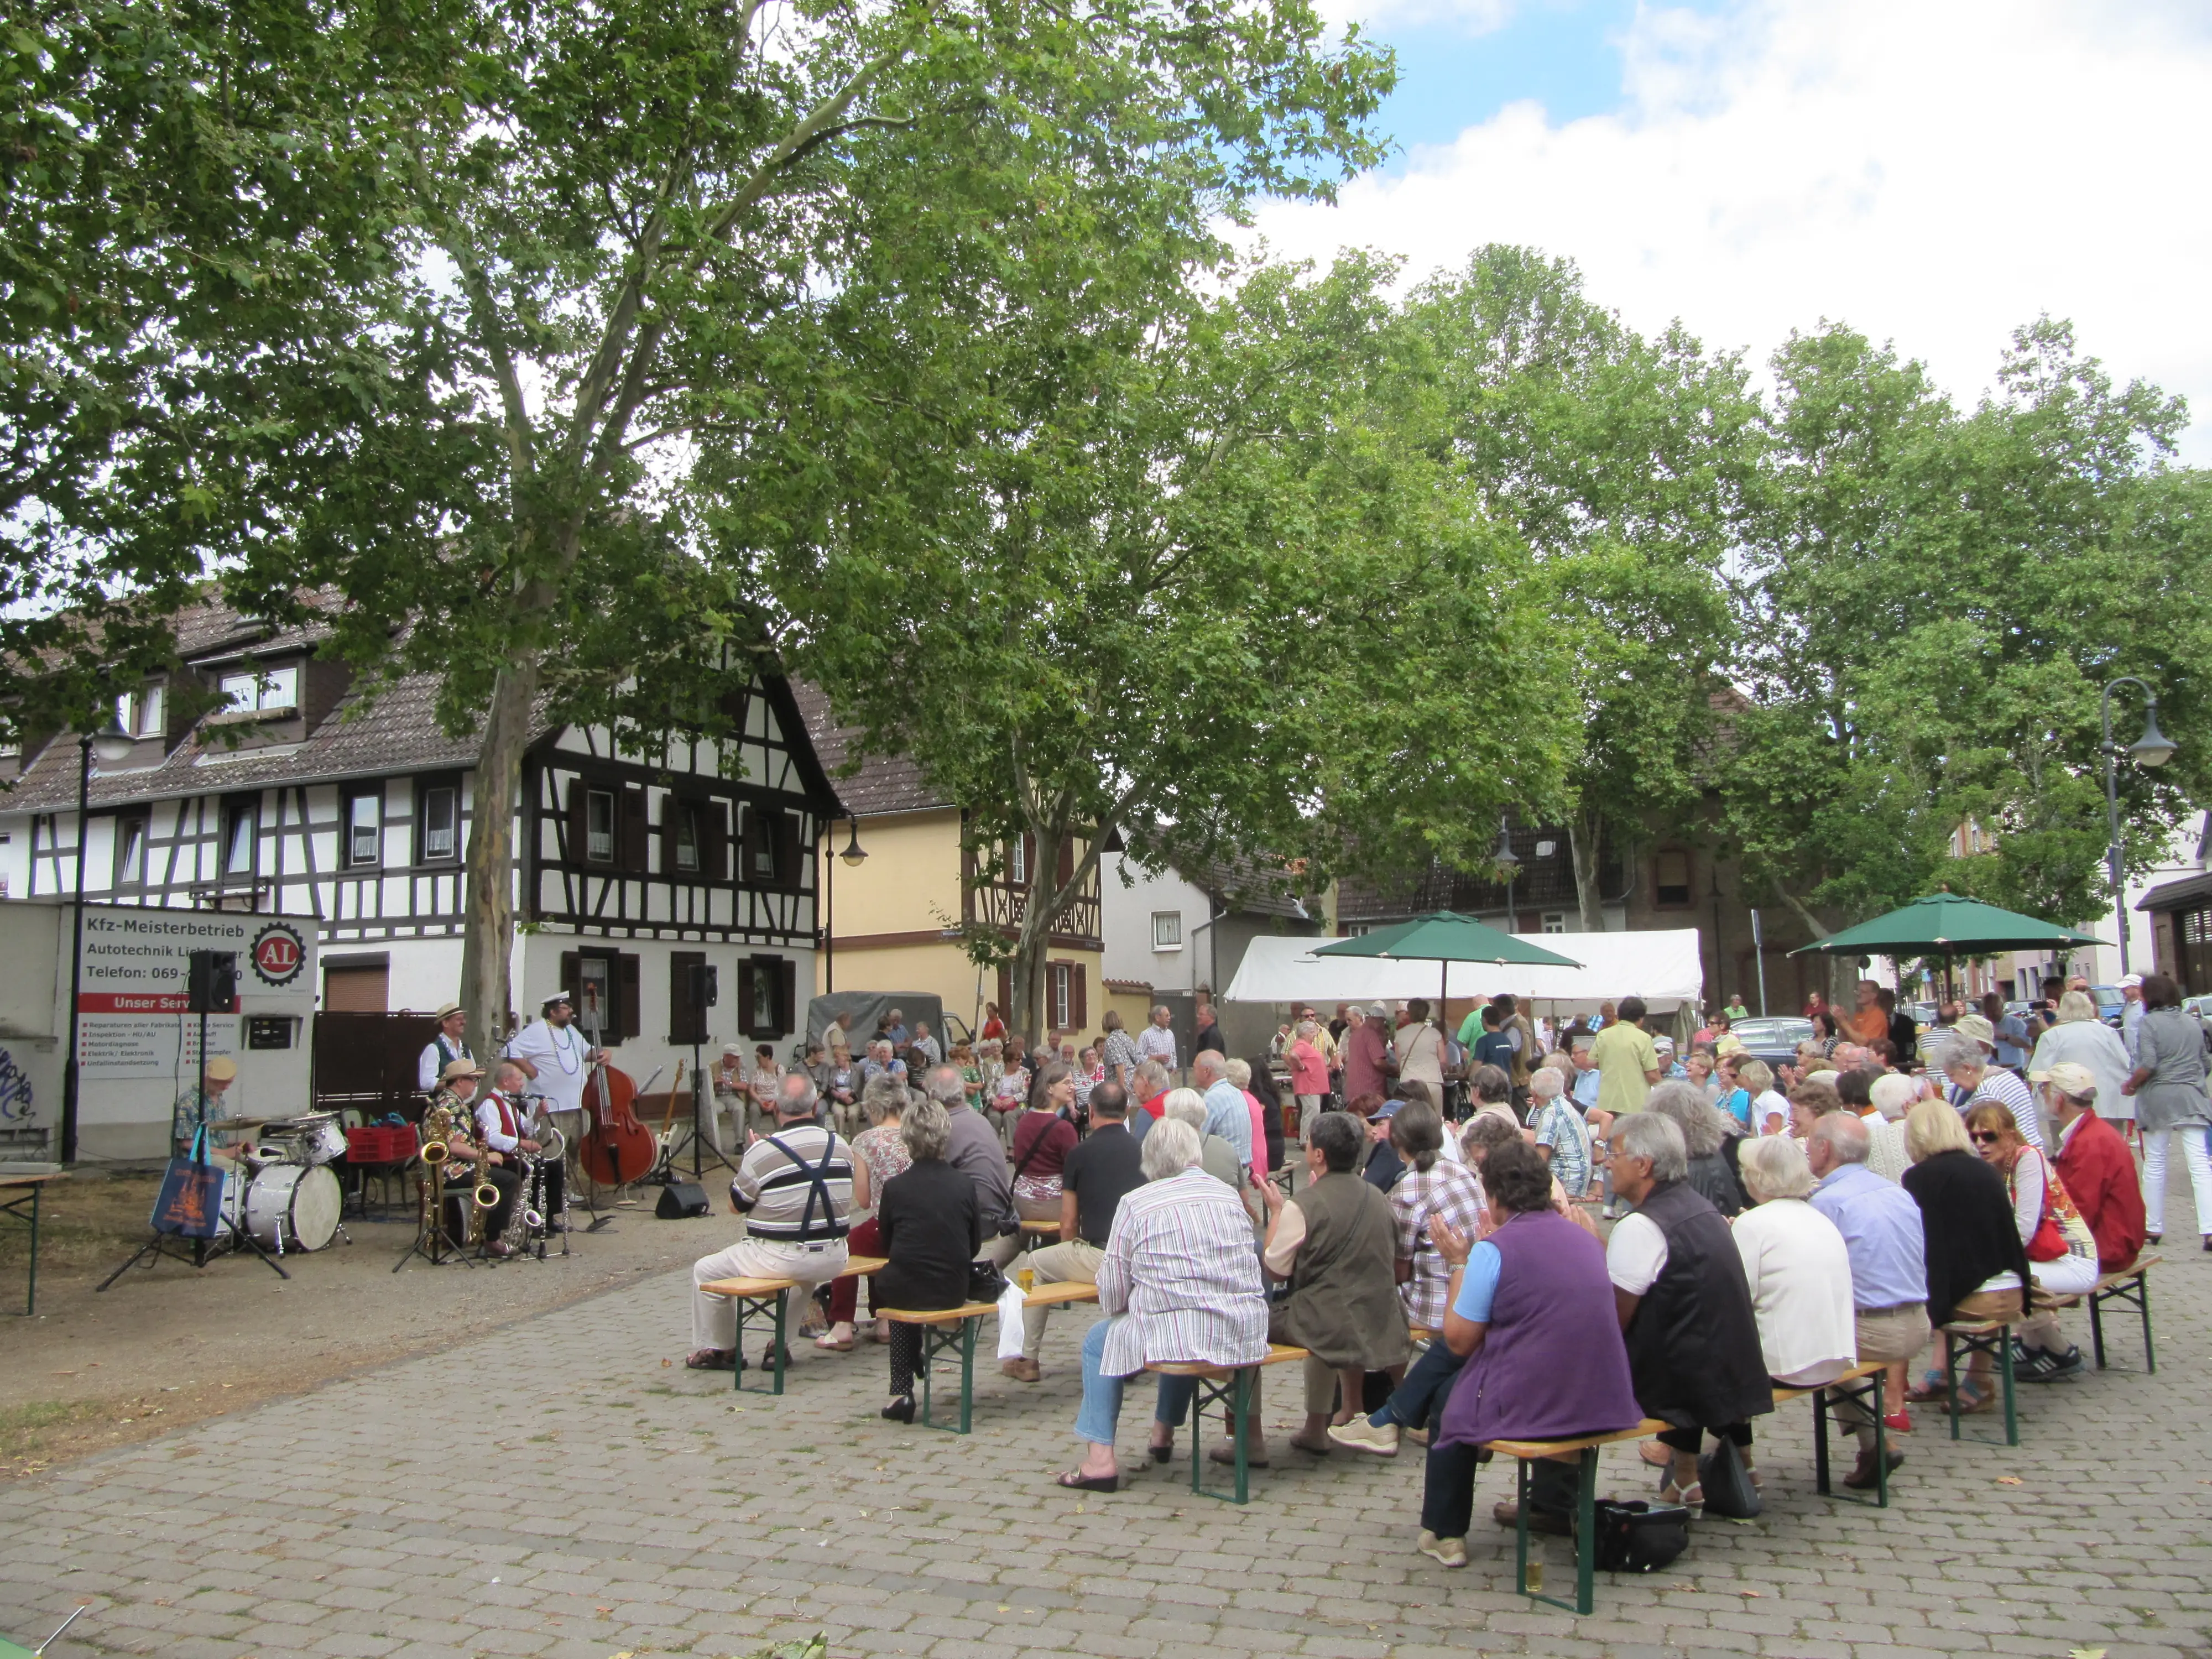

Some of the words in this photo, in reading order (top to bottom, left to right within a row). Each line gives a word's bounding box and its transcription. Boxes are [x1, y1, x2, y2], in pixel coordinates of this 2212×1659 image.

[87, 917, 244, 937] Kfz-Meisterbetrieb
[87, 943, 173, 957] Autotechnik
[262, 943, 296, 964] AL
[87, 966, 146, 978] Telefon:
[114, 997, 156, 1008] Unser
[160, 997, 190, 1009] Serv
